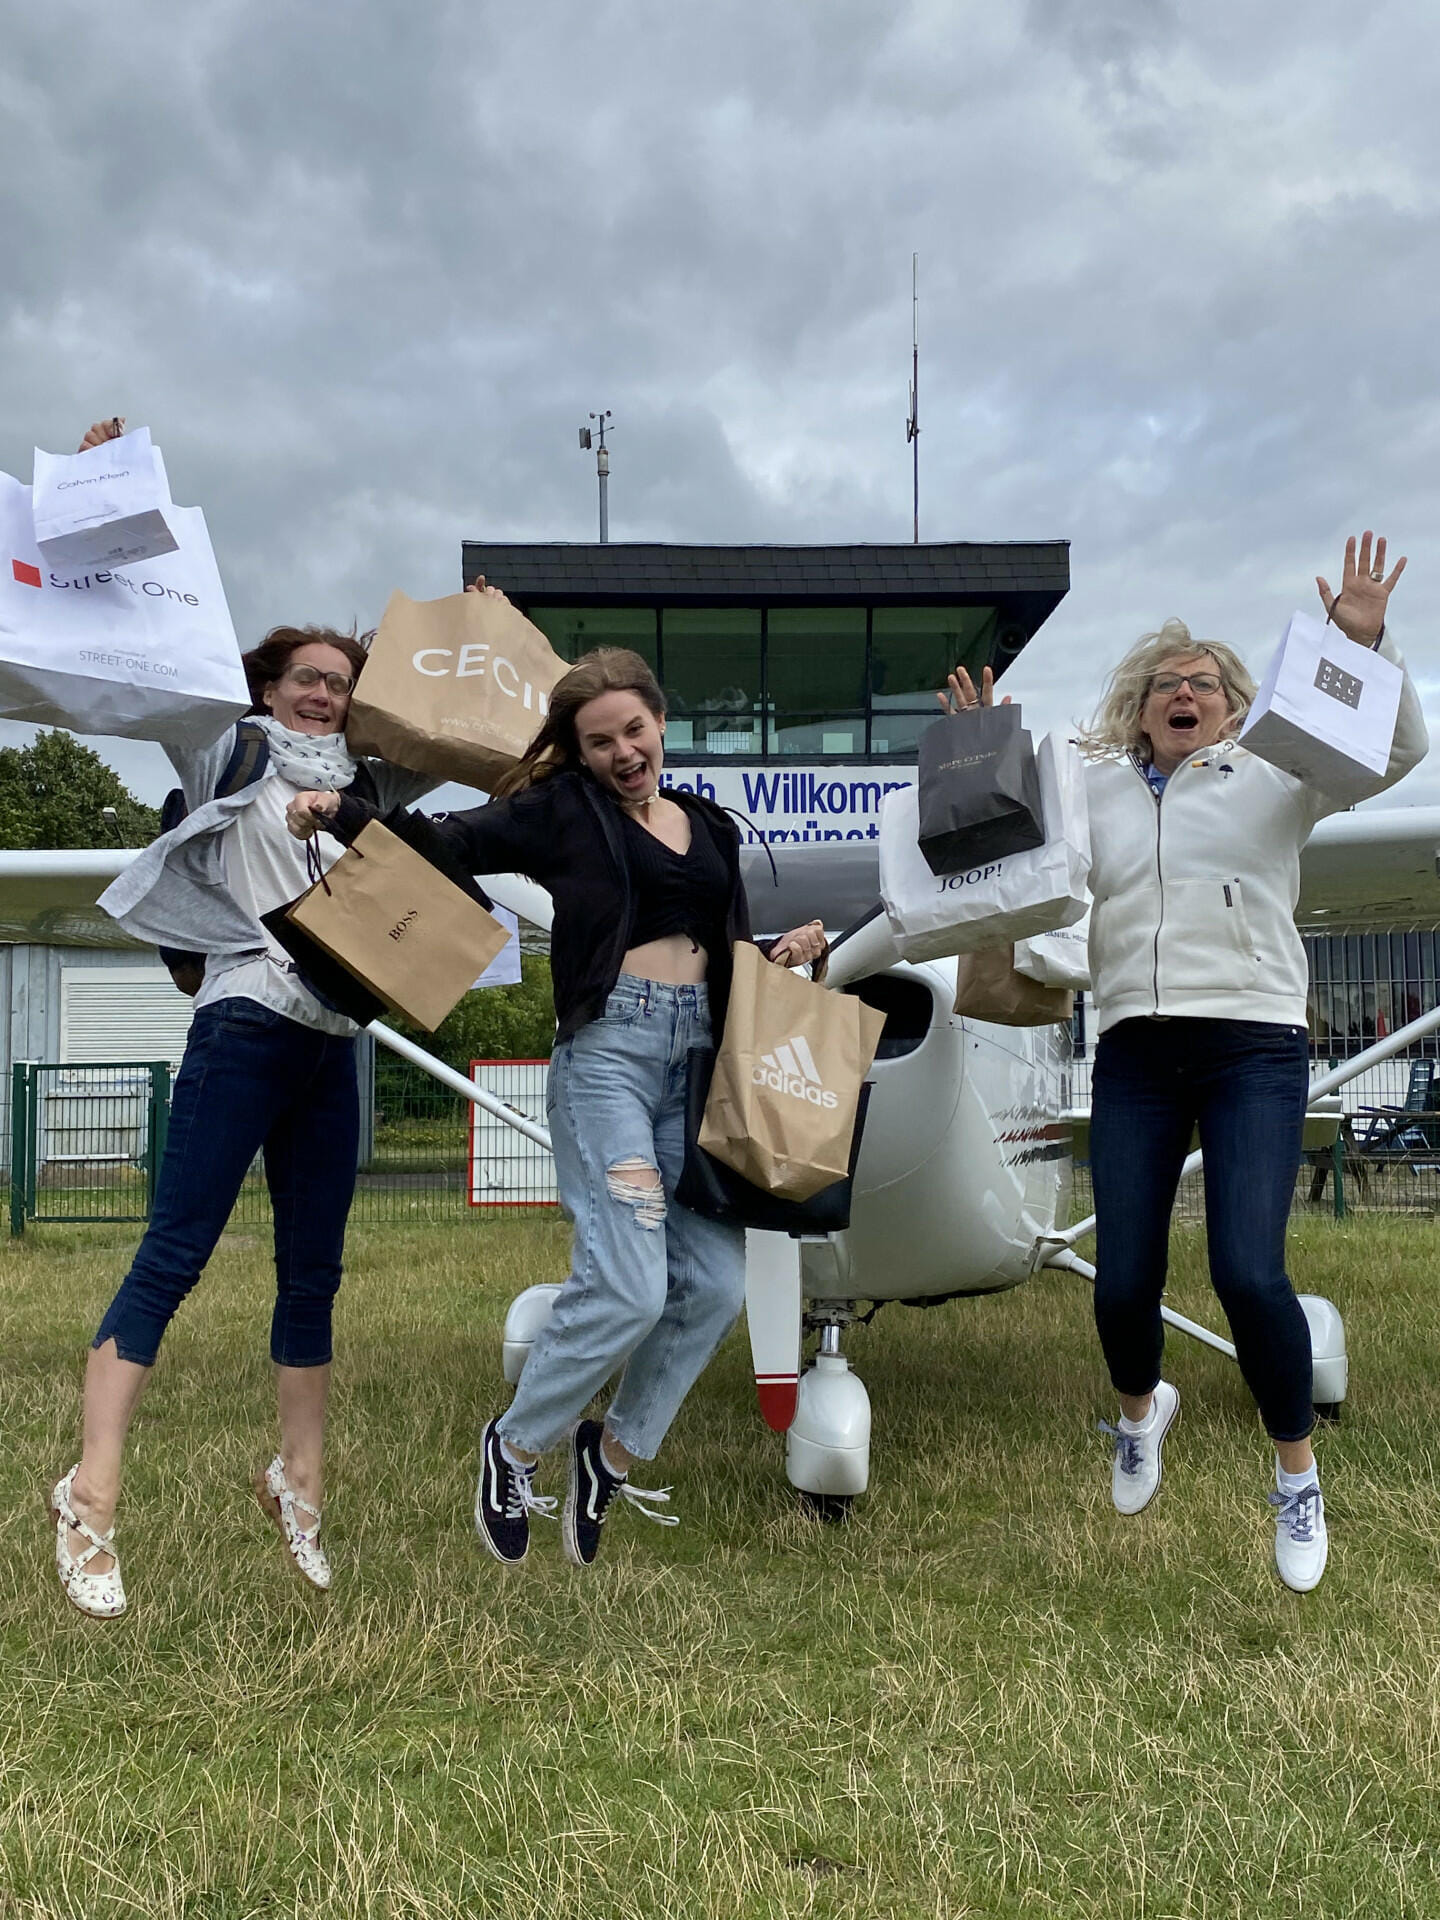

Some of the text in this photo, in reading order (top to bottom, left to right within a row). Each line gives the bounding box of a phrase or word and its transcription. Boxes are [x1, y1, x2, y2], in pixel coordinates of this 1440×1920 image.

[57, 471, 130, 490] Calvin Klein
[142, 582, 200, 606] One
[936, 863, 1002, 893] JOOP!
[388, 910, 418, 941] BOSS
[751, 1064, 838, 1109] adidas
